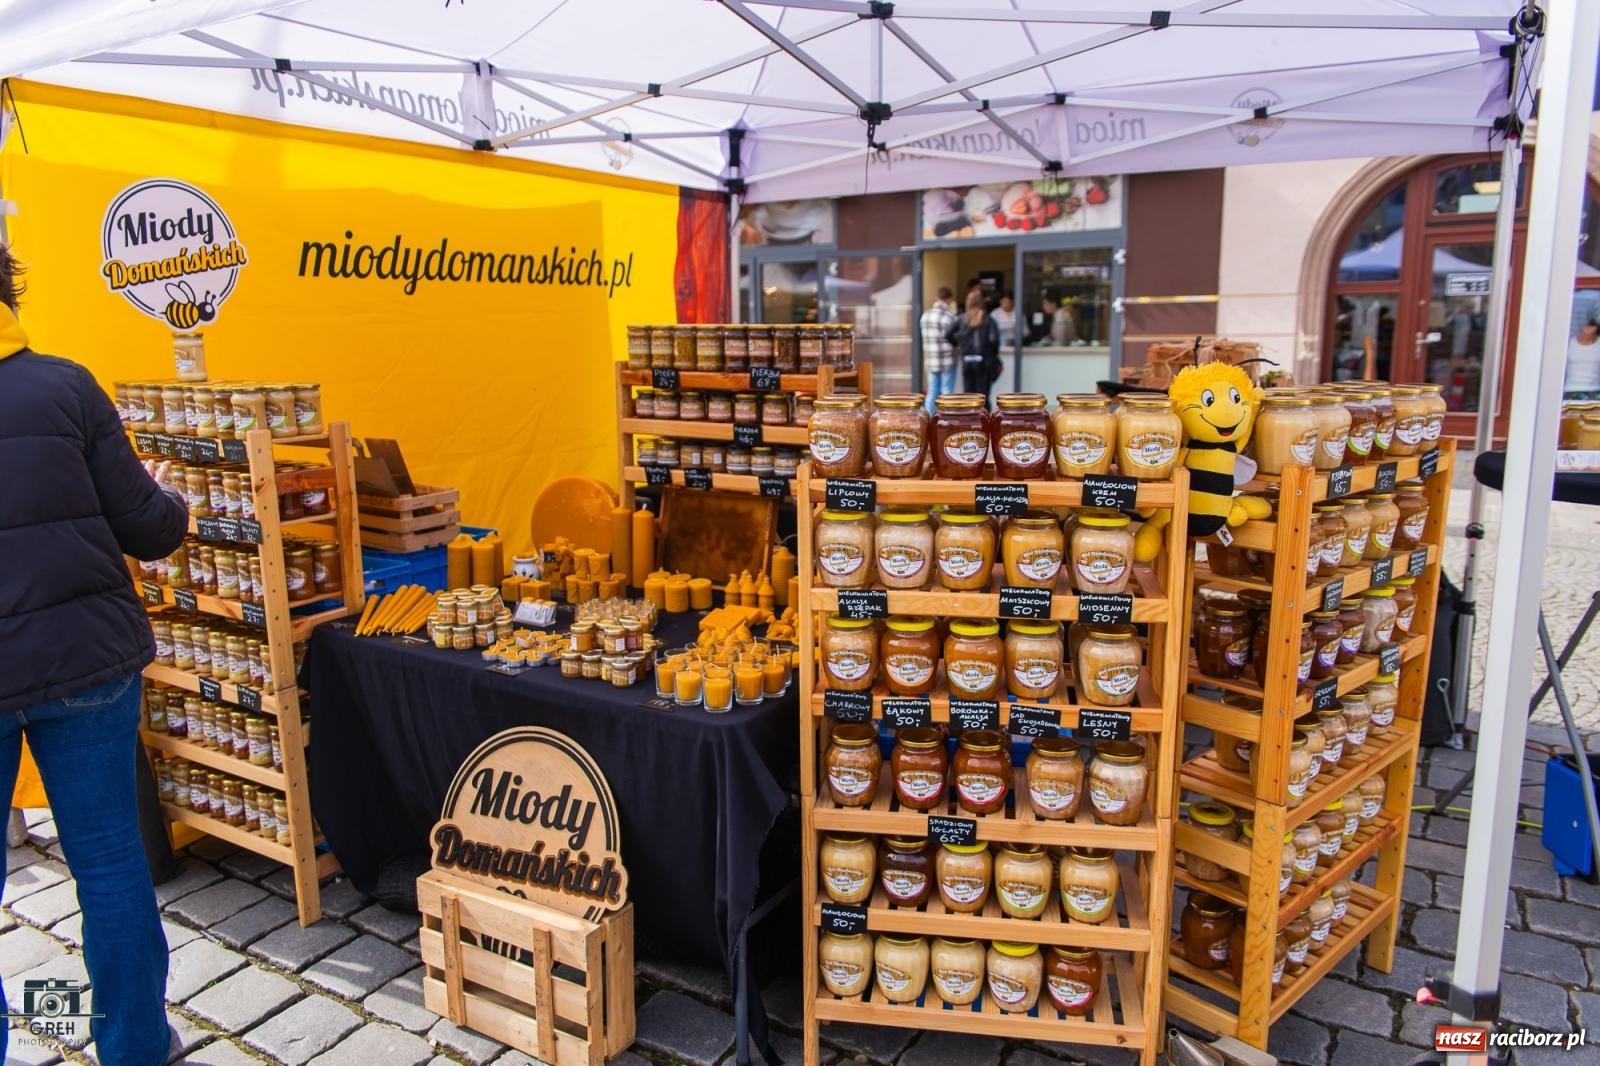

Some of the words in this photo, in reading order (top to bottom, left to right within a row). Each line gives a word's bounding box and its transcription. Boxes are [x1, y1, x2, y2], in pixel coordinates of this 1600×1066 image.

[117, 207, 213, 248] Miody
[103, 240, 247, 290] Domańskich
[297, 230, 634, 299] miodydomanskich.pl
[1092, 489, 1117, 497] KREM
[1000, 597, 1050, 607] MNISZKOWY
[1080, 603, 1130, 614] WIOSENNY
[824, 700, 870, 712] CHABROWY
[886, 708, 925, 718] ŁĄKOWY
[959, 714, 989, 722] AKACJA
[1082, 718, 1118, 728] LEŚNY
[470, 767, 597, 851] Miody
[929, 818, 974, 828] SPADZIOWY
[931, 826, 972, 836] IGLASTY
[434, 823, 621, 903] Domańskich
